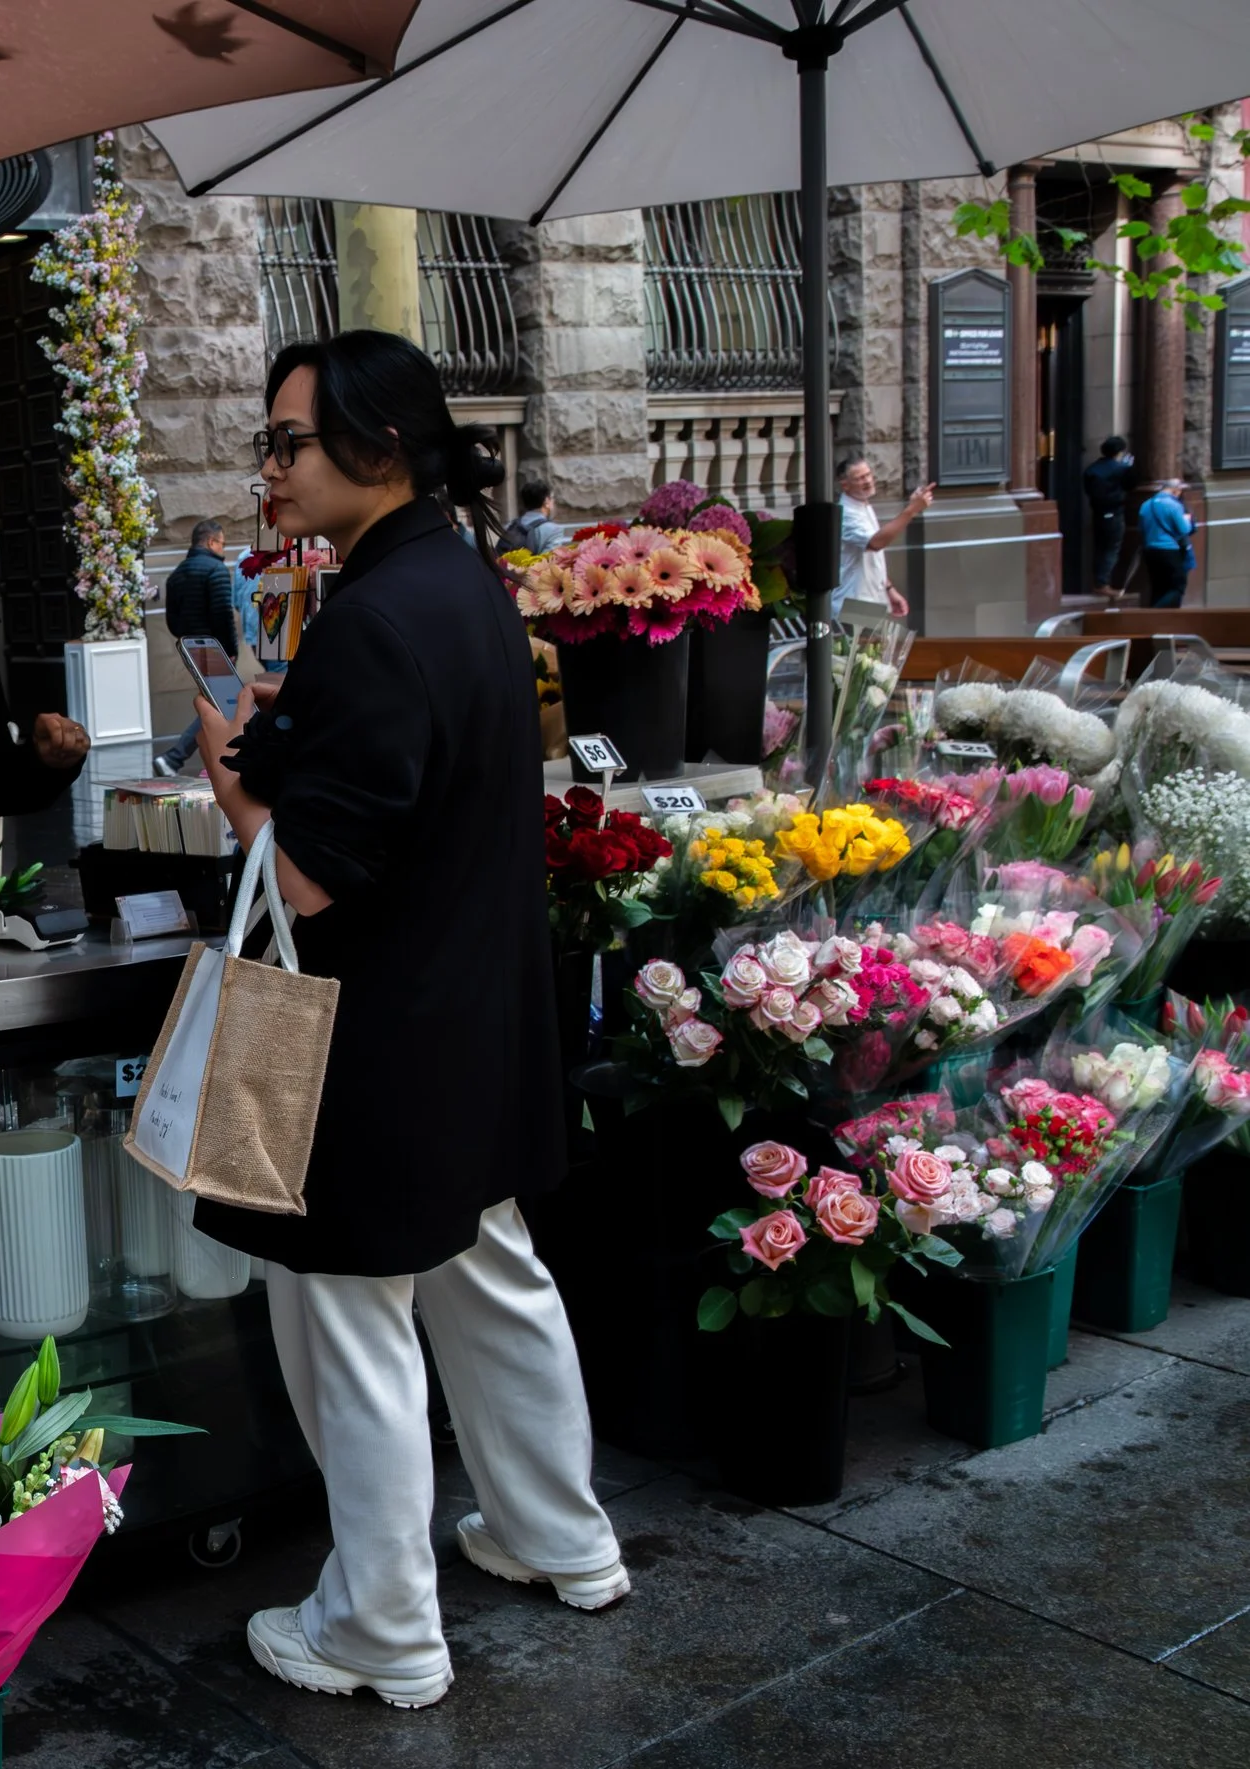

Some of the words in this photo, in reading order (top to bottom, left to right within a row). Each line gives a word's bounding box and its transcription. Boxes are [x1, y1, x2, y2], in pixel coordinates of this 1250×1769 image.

[584, 744, 607, 762] $6
[949, 744, 989, 753] $25
[654, 796, 694, 809] $20
